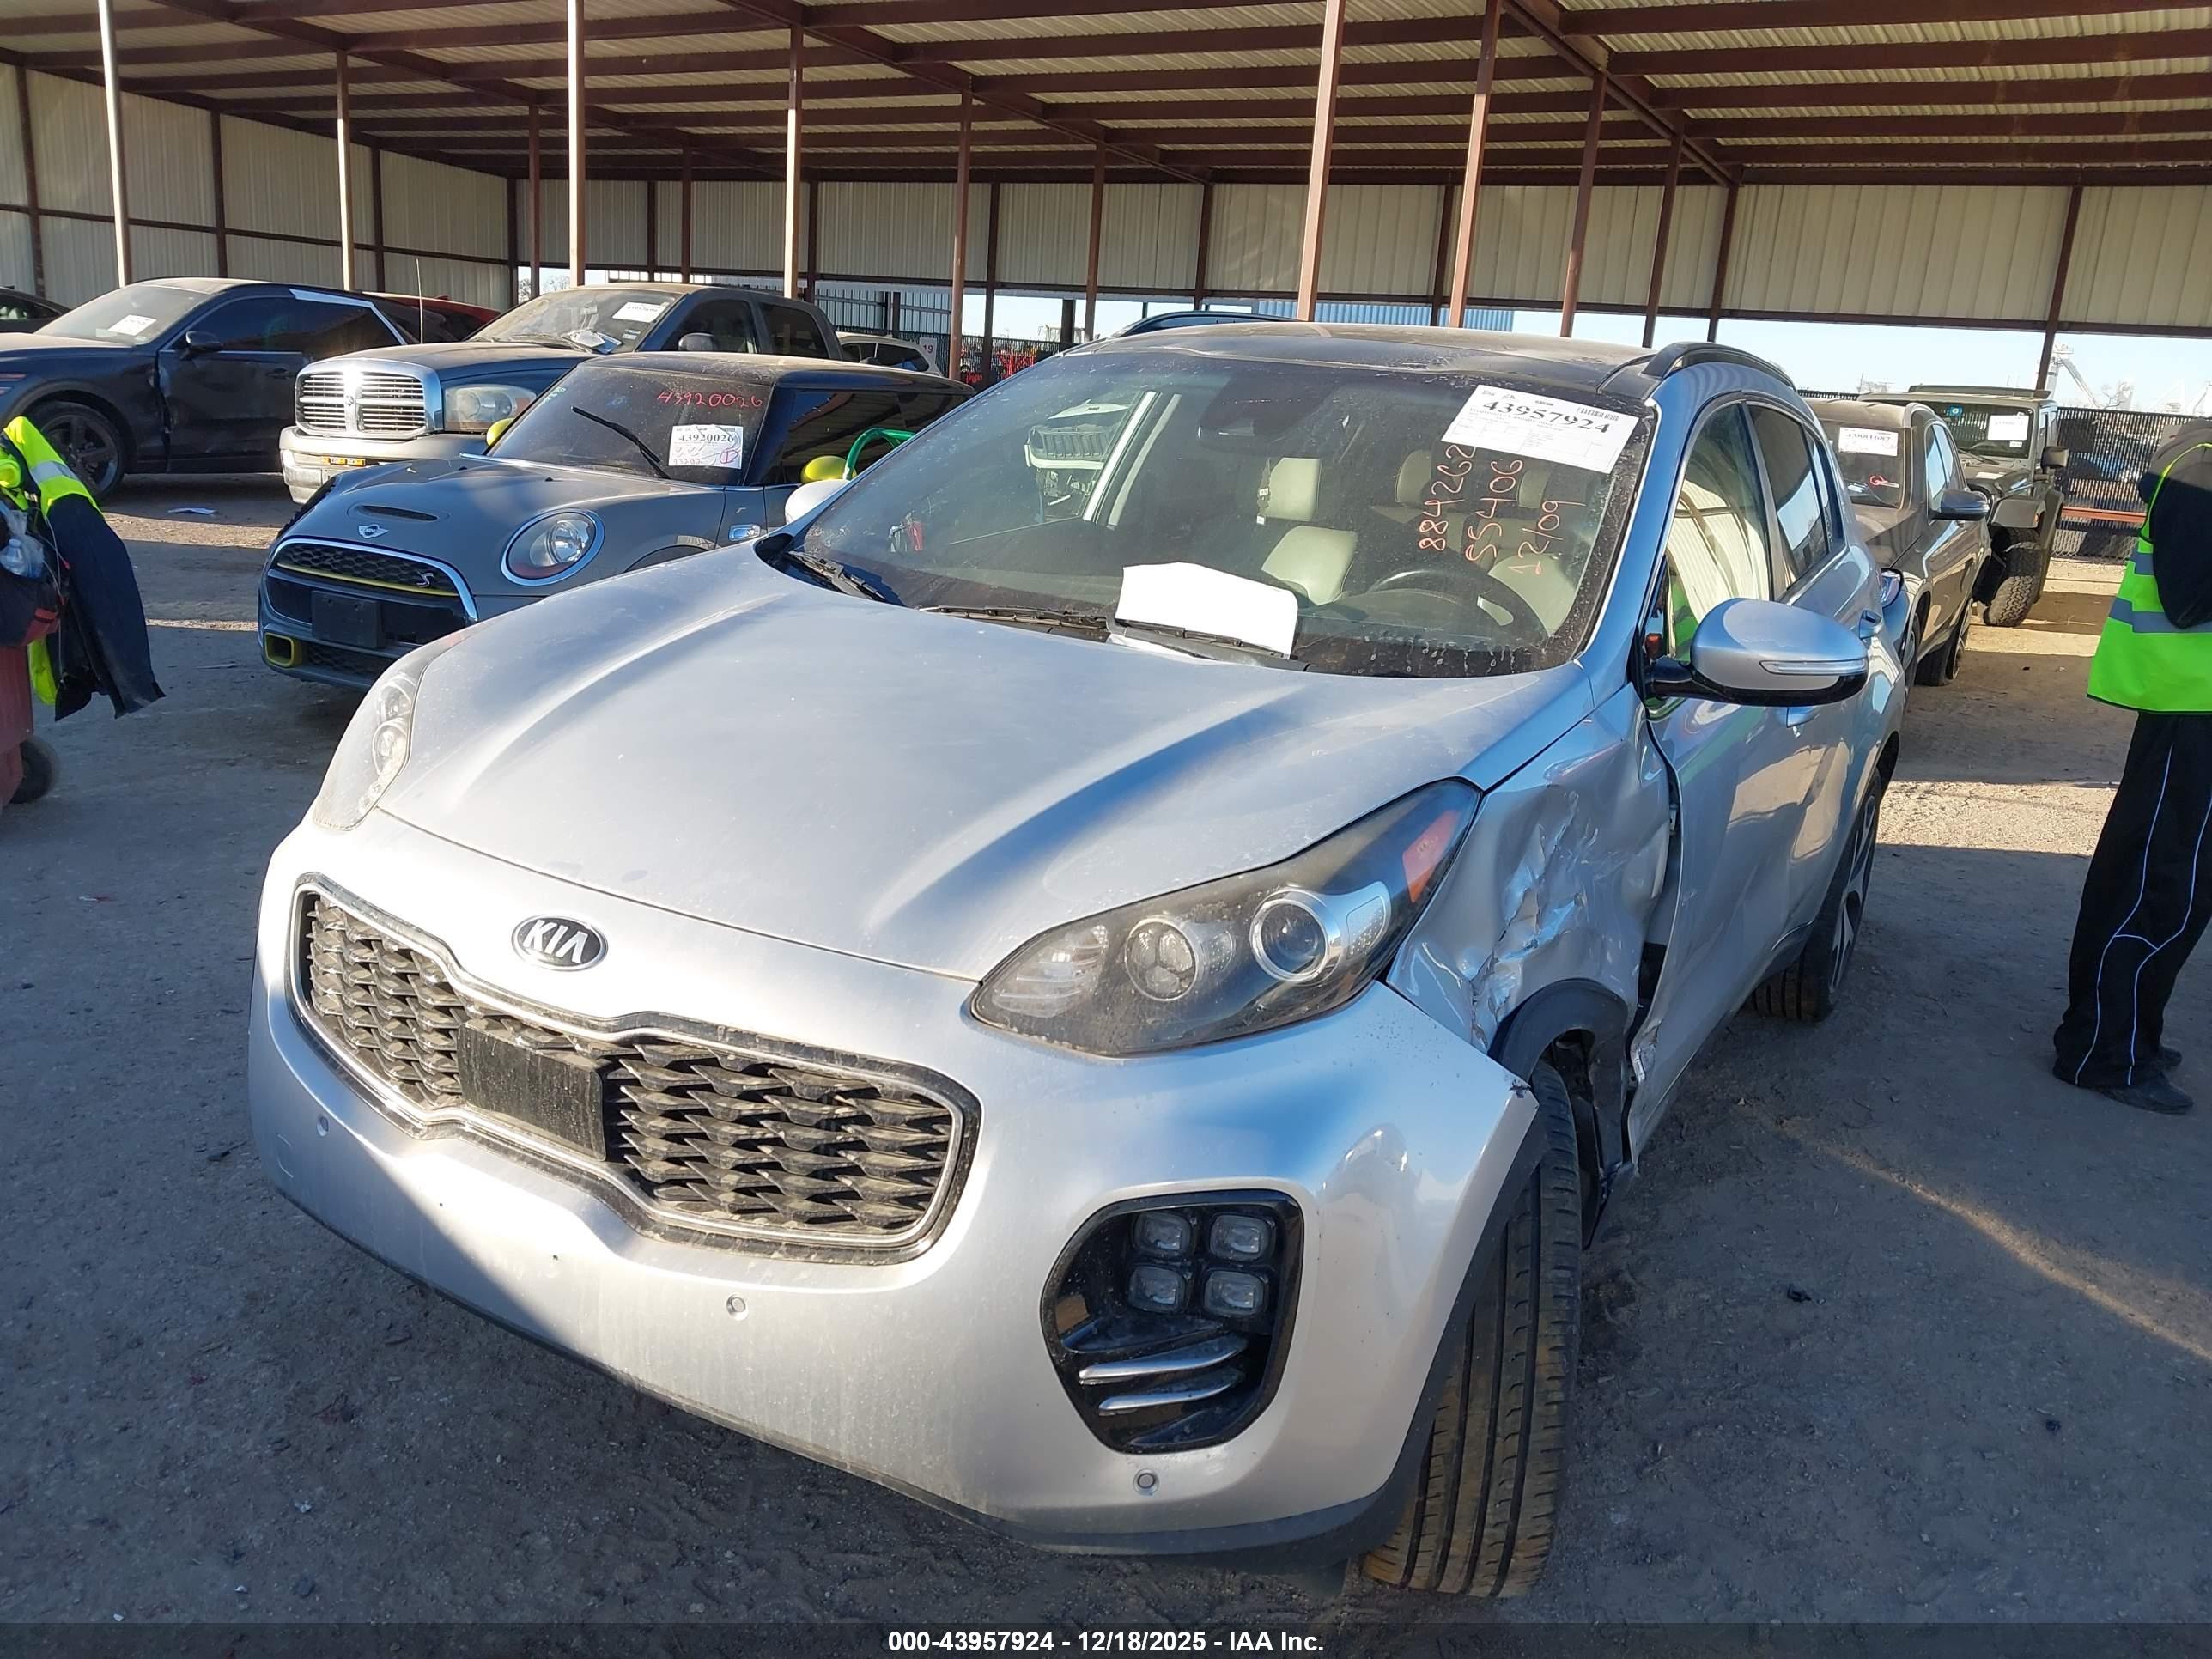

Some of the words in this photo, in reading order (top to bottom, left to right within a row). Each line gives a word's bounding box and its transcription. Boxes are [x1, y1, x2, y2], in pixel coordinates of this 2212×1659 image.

[922, 343, 933, 354] 19
[656, 390, 763, 408] 43920026
[1482, 399, 1611, 434] 43957924
[678, 433, 734, 443] 43920026
[522, 919, 588, 964] KIA
